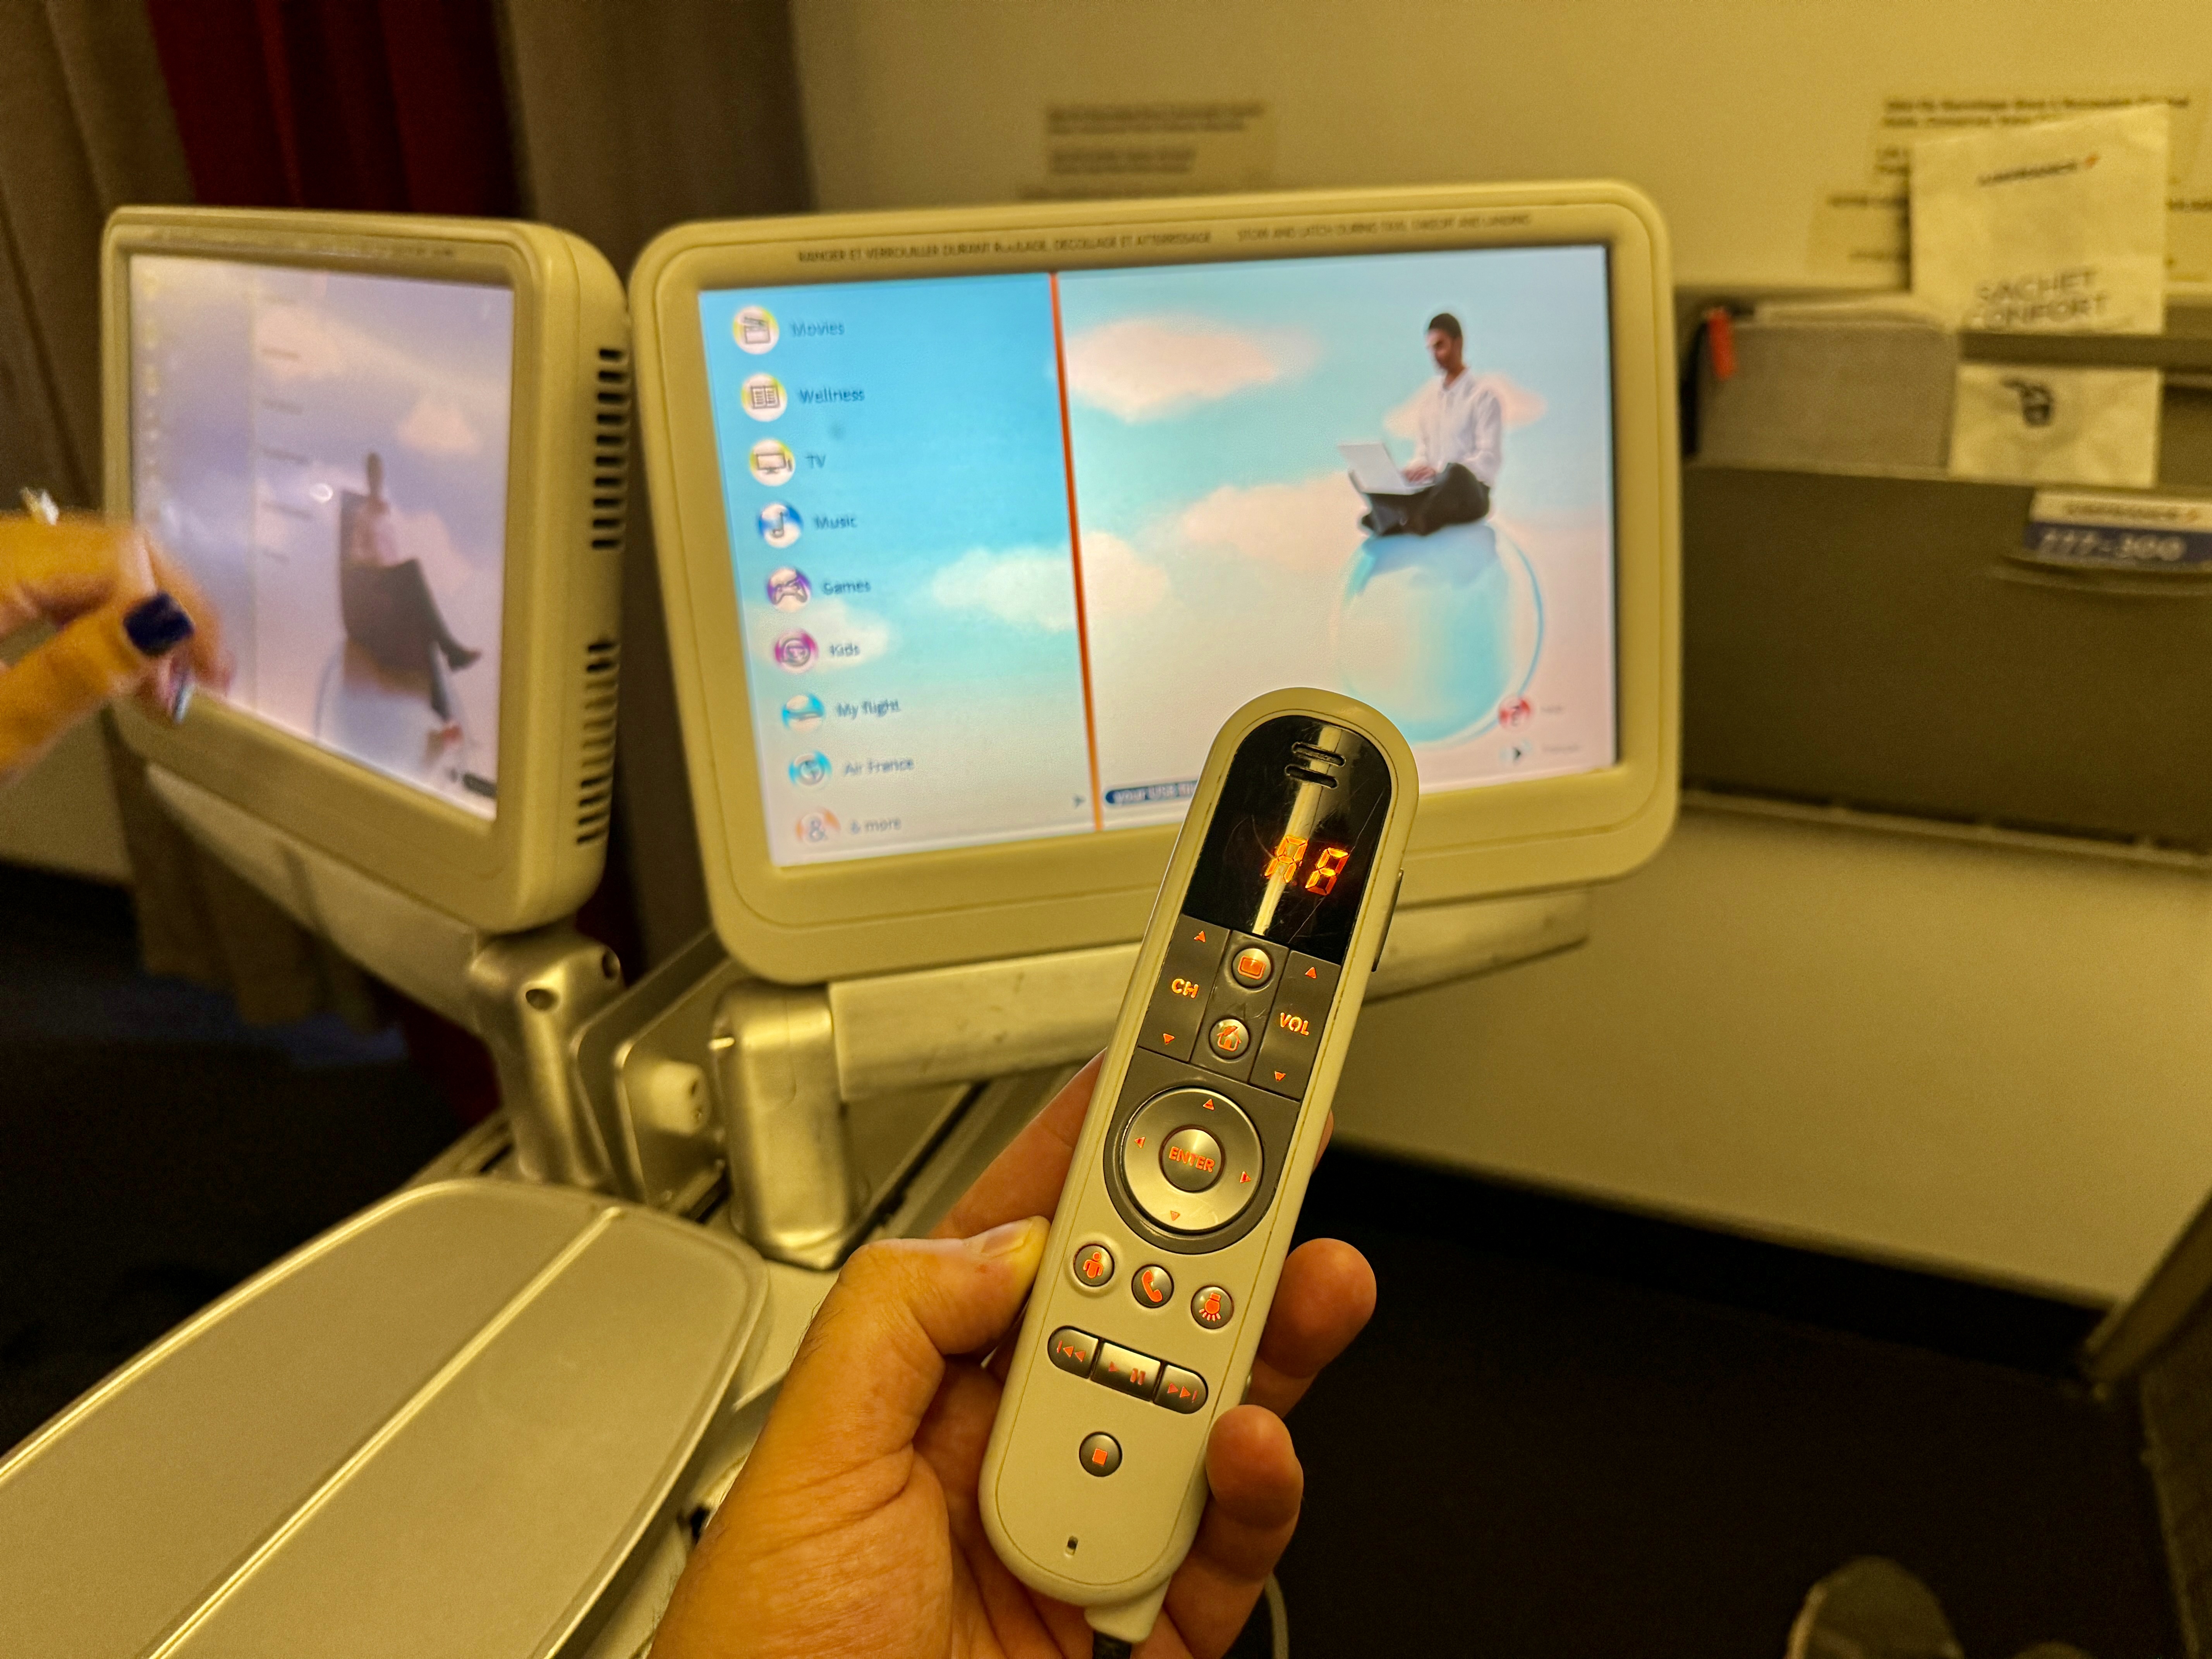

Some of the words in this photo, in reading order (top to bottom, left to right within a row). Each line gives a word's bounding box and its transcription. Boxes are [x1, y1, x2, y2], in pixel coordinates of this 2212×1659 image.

[850, 248, 861, 260] ET
[791, 320, 845, 338] Movies
[798, 387, 865, 404] Wellness
[805, 453, 826, 468] TV
[814, 512, 858, 530] Music
[822, 579, 871, 595] Games
[829, 643, 860, 657] Kids
[836, 702, 857, 720] My
[862, 699, 901, 718] flight
[843, 763, 864, 777] Air
[868, 757, 914, 773] France
[865, 817, 902, 831] more
[1171, 978, 1199, 998] CH
[1280, 1012, 1310, 1036] VOL
[1169, 1146, 1215, 1173] ENTER
